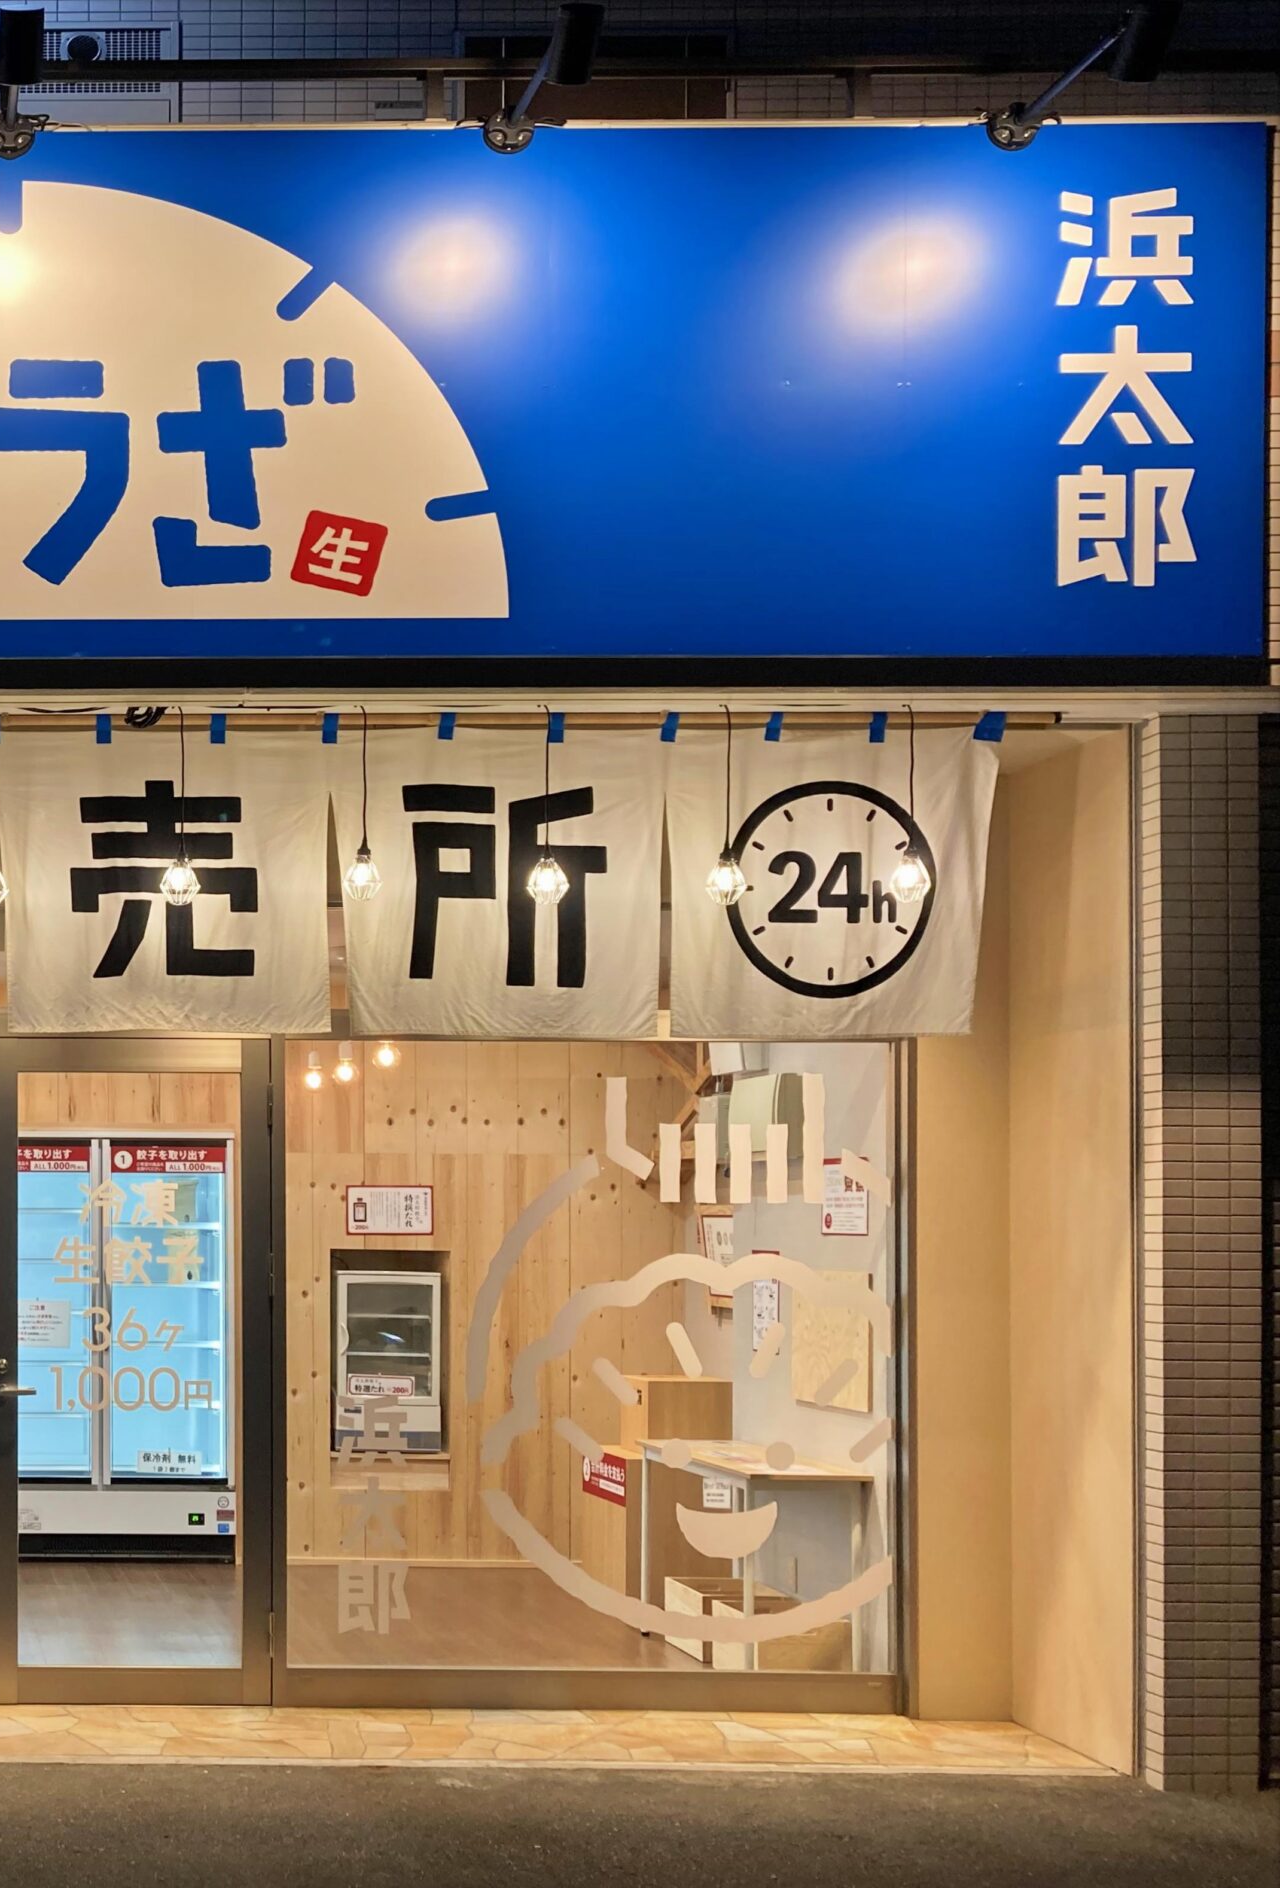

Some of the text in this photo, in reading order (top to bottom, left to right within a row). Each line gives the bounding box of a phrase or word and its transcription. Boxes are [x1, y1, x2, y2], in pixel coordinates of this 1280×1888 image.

[1056, 187, 1197, 587] 浜太郎
[307, 525, 371, 586] 生
[768, 850, 897, 923] 24h
[136, 1149, 207, 1160] 餃子を取り出す
[79, 1179, 179, 1227] 冷凍
[53, 1237, 205, 1285] 生餃子
[49, 1366, 213, 1412] 1,000円
[336, 1395, 411, 1635] 浜太郎
